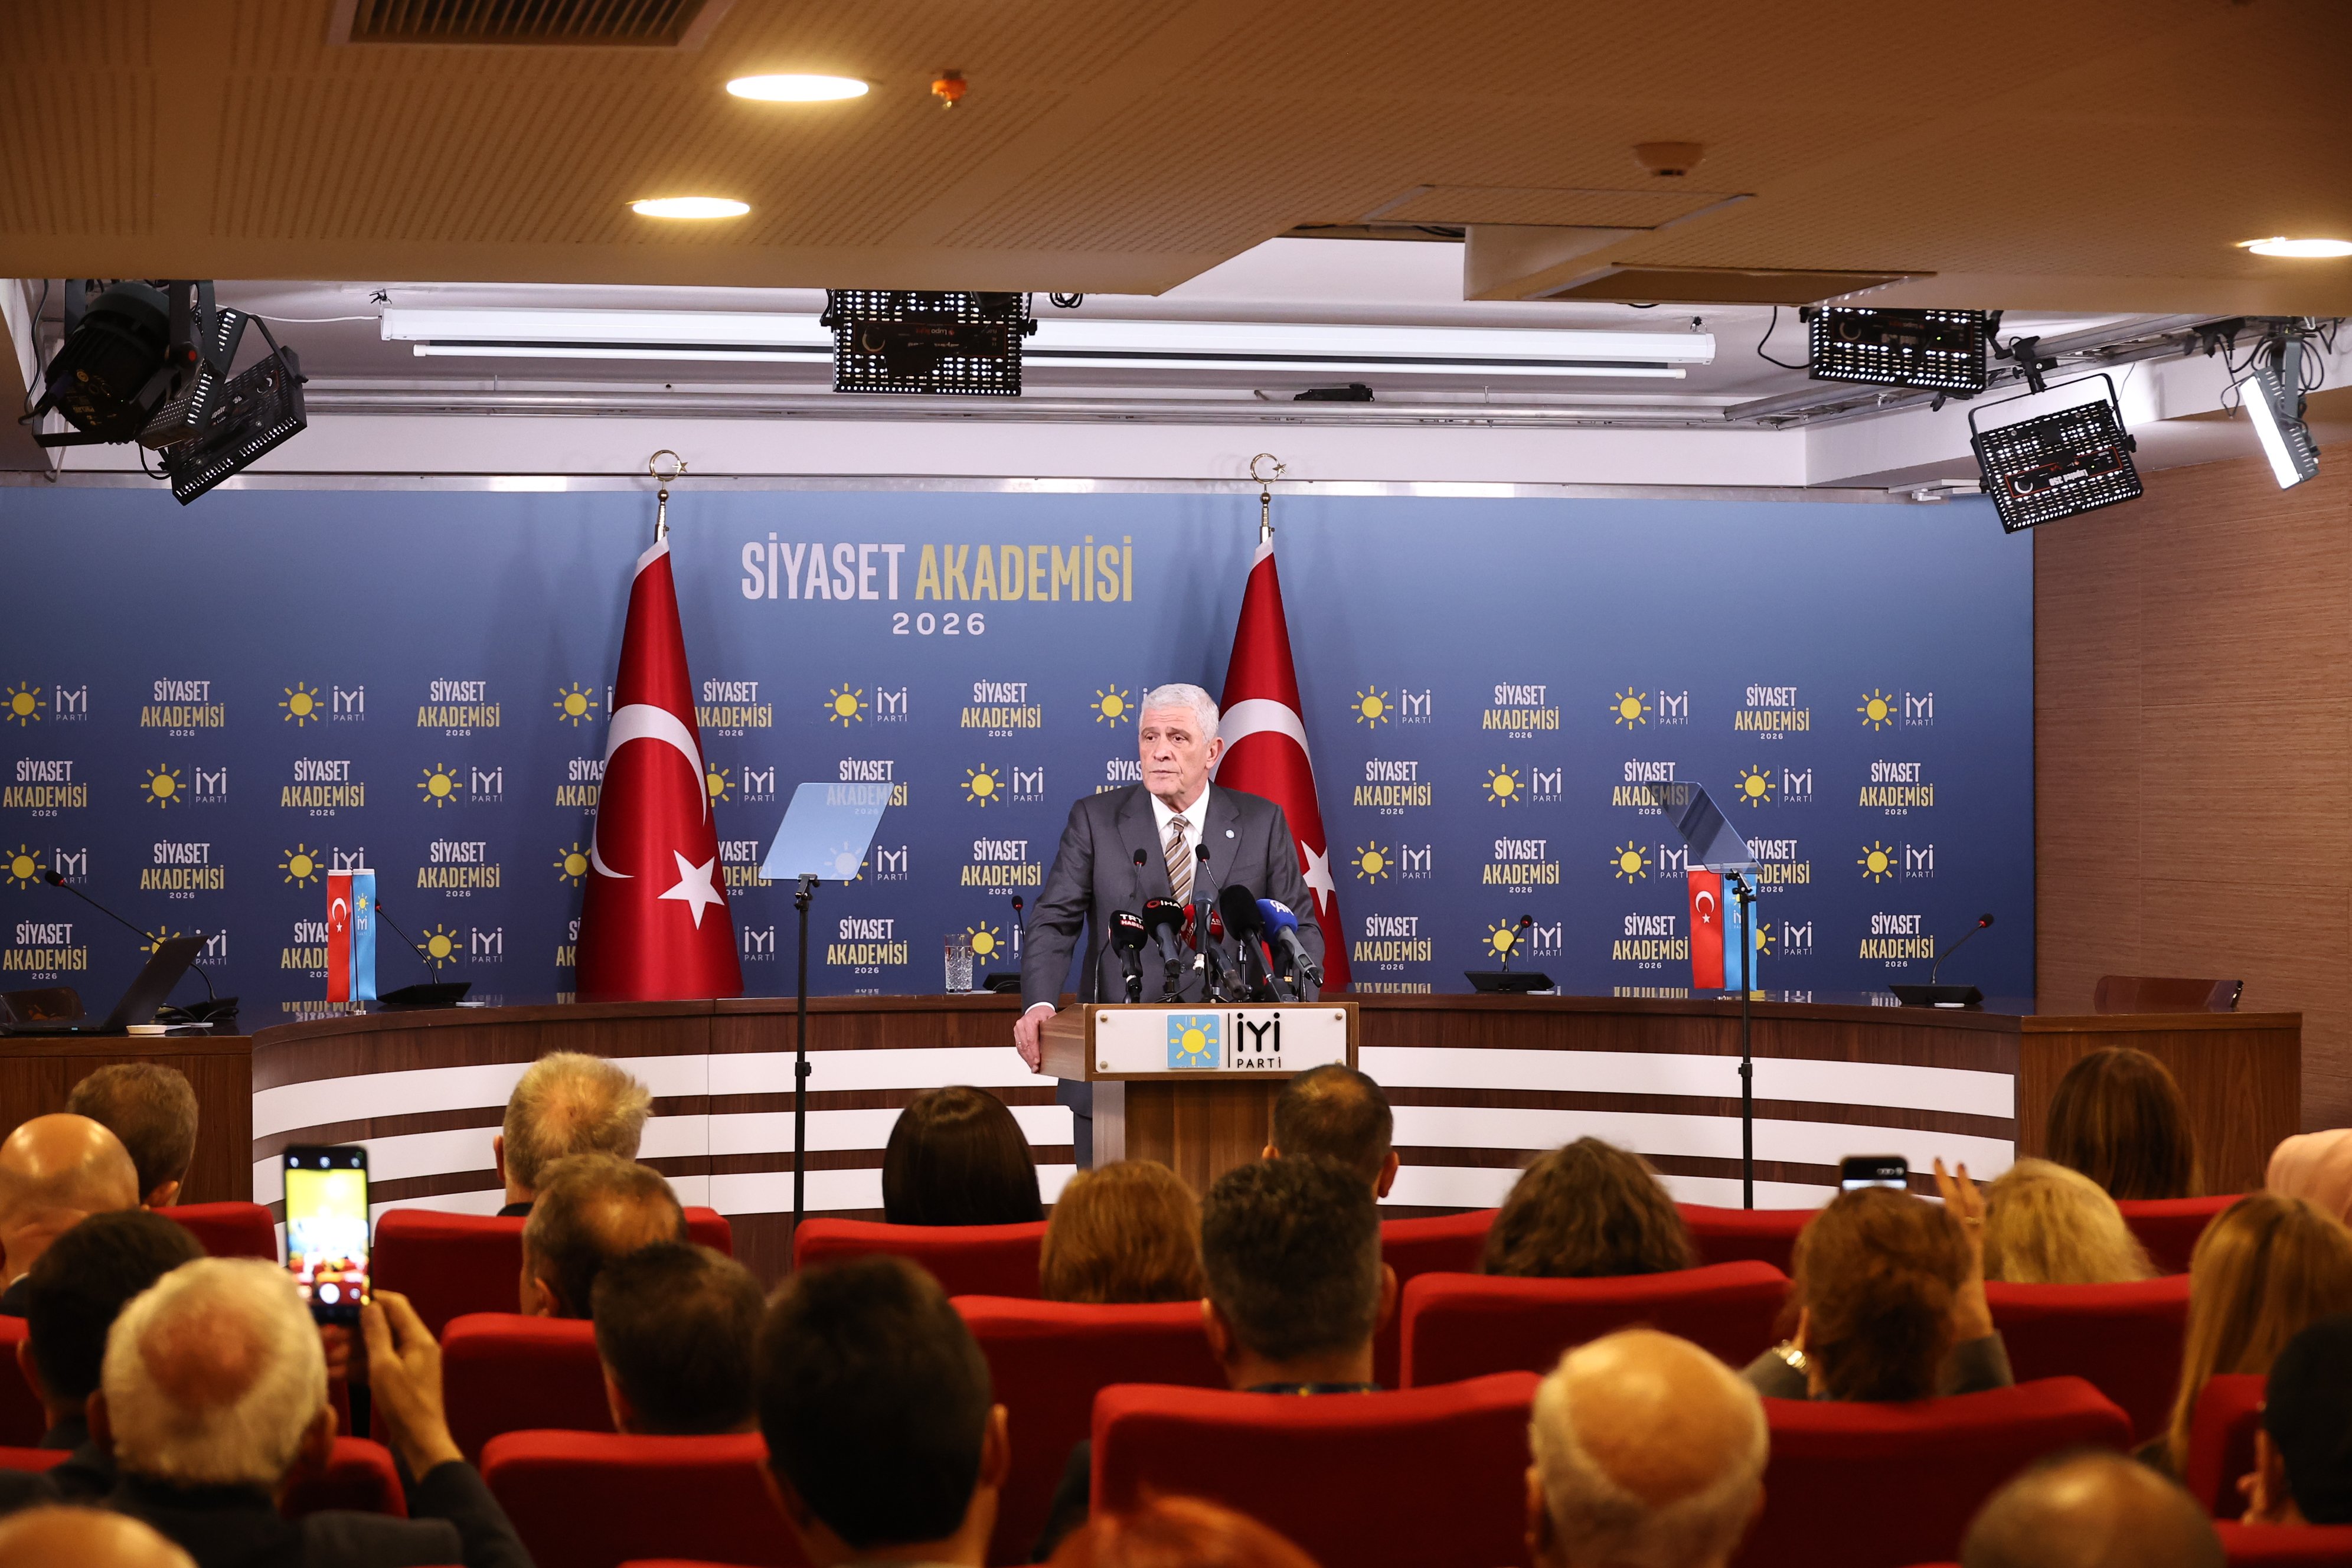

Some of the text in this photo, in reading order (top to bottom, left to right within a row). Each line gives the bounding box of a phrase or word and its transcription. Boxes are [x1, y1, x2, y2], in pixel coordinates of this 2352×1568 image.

[741, 532, 1132, 602] SİYASET AKADEMİSİ
[892, 612, 985, 636] 2026
[56, 685, 87, 713] İYİ
[153, 677, 211, 702] SİYASET
[333, 685, 364, 713] İYİ
[430, 677, 486, 702] SİYASET
[703, 678, 759, 703] SİYASET
[877, 687, 907, 714] İYİ
[973, 679, 1028, 703] SİYASET
[1402, 688, 1431, 716] İYİ
[1494, 681, 1547, 705] SİYASET
[1746, 683, 1797, 707] SİYASET
[140, 702, 224, 728] AKADEMİSİ
[417, 702, 500, 727] AKADEMİSİ
[961, 703, 1041, 729] AKADEMİSİ
[1660, 690, 1688, 717] İYİ
[1905, 692, 1933, 718] İYİ
[877, 714, 907, 722] PARTİ
[1402, 716, 1431, 724] PARTİ
[1482, 705, 1559, 730] AKADEMİSİ
[1660, 717, 1688, 725] PARTİ
[1734, 707, 1809, 731] AKADEMİSİ
[16, 757, 73, 782] SİYASET
[195, 766, 227, 795] İYİ
[294, 757, 351, 782] SİYASET
[472, 766, 502, 794] İYİ
[744, 766, 775, 793] İYİ
[839, 756, 894, 781] SİYASET
[1013, 766, 1043, 794] İYİ
[1106, 757, 1143, 781] SİYAS
[1366, 757, 1418, 782] SİYASET
[1533, 767, 1562, 794] İYİ
[1624, 758, 1676, 782] SİYASET
[1871, 759, 1921, 783] SİYASET
[1353, 782, 1431, 806] AKADEMİSİ
[1783, 767, 1812, 796] İYİ
[2, 782, 87, 808] AKADEMİSİ
[195, 795, 227, 803] PARTİ
[280, 782, 364, 807] AKADEMİSİ
[472, 794, 502, 802] PARTİ
[744, 793, 775, 802] PARTİ
[1014, 793, 1043, 802] PARTİ
[1533, 794, 1562, 802] PARTİ
[1859, 783, 1933, 807] AKADEMİSİ
[153, 839, 210, 864] SİYASET
[430, 838, 486, 863] SİYASET
[718, 840, 759, 861] YASET
[877, 845, 907, 873] İYİ
[974, 837, 1028, 861] SİYASET
[1402, 844, 1431, 871] İYİ
[1494, 836, 1547, 860] SİYASET
[1746, 836, 1798, 860] SİYASET
[1906, 844, 1933, 871] İYİ
[55, 847, 87, 876] İYİ
[961, 861, 1041, 886] AKADEMİSİ
[1482, 860, 1560, 885] AKADEMİSİ
[63, 876, 87, 884] ARTİ
[140, 864, 224, 890] AKADEMİSİ
[417, 863, 500, 888] AKADEMİSİ
[877, 873, 907, 881] PARTİ
[1402, 871, 1431, 879] PARTİ
[357, 915, 367, 930] İYİ
[839, 915, 894, 940] SİYASET
[1120, 914, 1144, 925] TRT
[1120, 920, 1144, 930] HABER
[1366, 913, 1419, 937] SİYASET
[1624, 912, 1676, 936] SİYASET
[1871, 911, 1922, 935] SİYASET
[16, 920, 73, 945] SİYASET
[472, 927, 502, 955] İYİ
[744, 925, 775, 953] İYİ
[1533, 922, 1562, 949] İYİ
[1784, 920, 1812, 949] İYİ
[2, 945, 87, 971] AKADEMİSİ
[472, 955, 502, 963] PARTİ
[827, 940, 908, 965] AKADEMİSİ
[1354, 937, 1432, 962] AKADEMİSİ
[1533, 948, 1562, 957] PARTİ
[1612, 936, 1688, 961] AKADEMİSİ
[1859, 935, 1934, 959] AKADEMİSİ
[195, 956, 227, 966] PARTİ
[1237, 1012, 1280, 1053] İYİ
[1237, 1056, 1281, 1069] PARTİ
